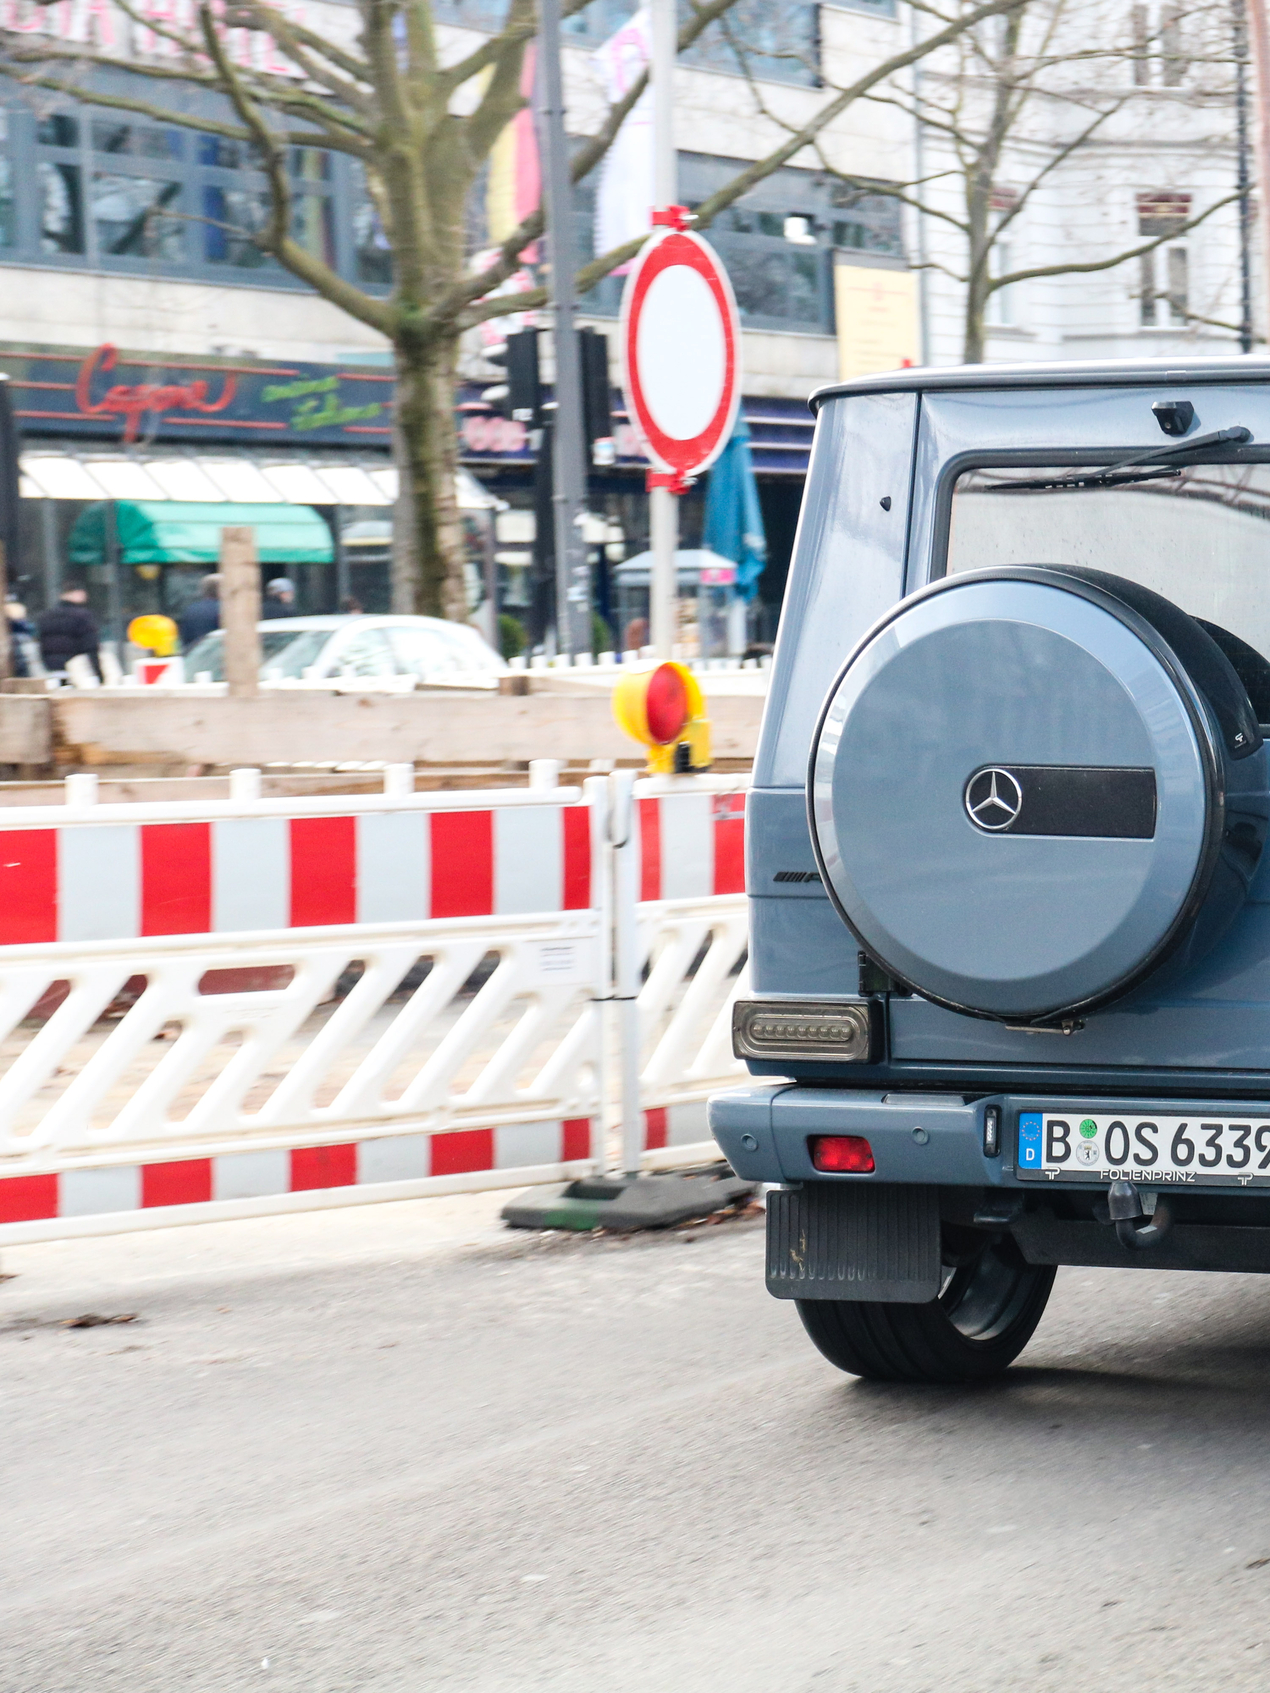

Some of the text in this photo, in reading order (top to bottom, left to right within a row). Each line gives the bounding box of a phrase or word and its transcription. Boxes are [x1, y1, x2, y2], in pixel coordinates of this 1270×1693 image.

[1045, 1119, 1071, 1164] B
[1104, 1120, 1159, 1166] OS
[1025, 1148, 1035, 1161] D
[1100, 1169, 1197, 1182] FOLIENPRINZ
